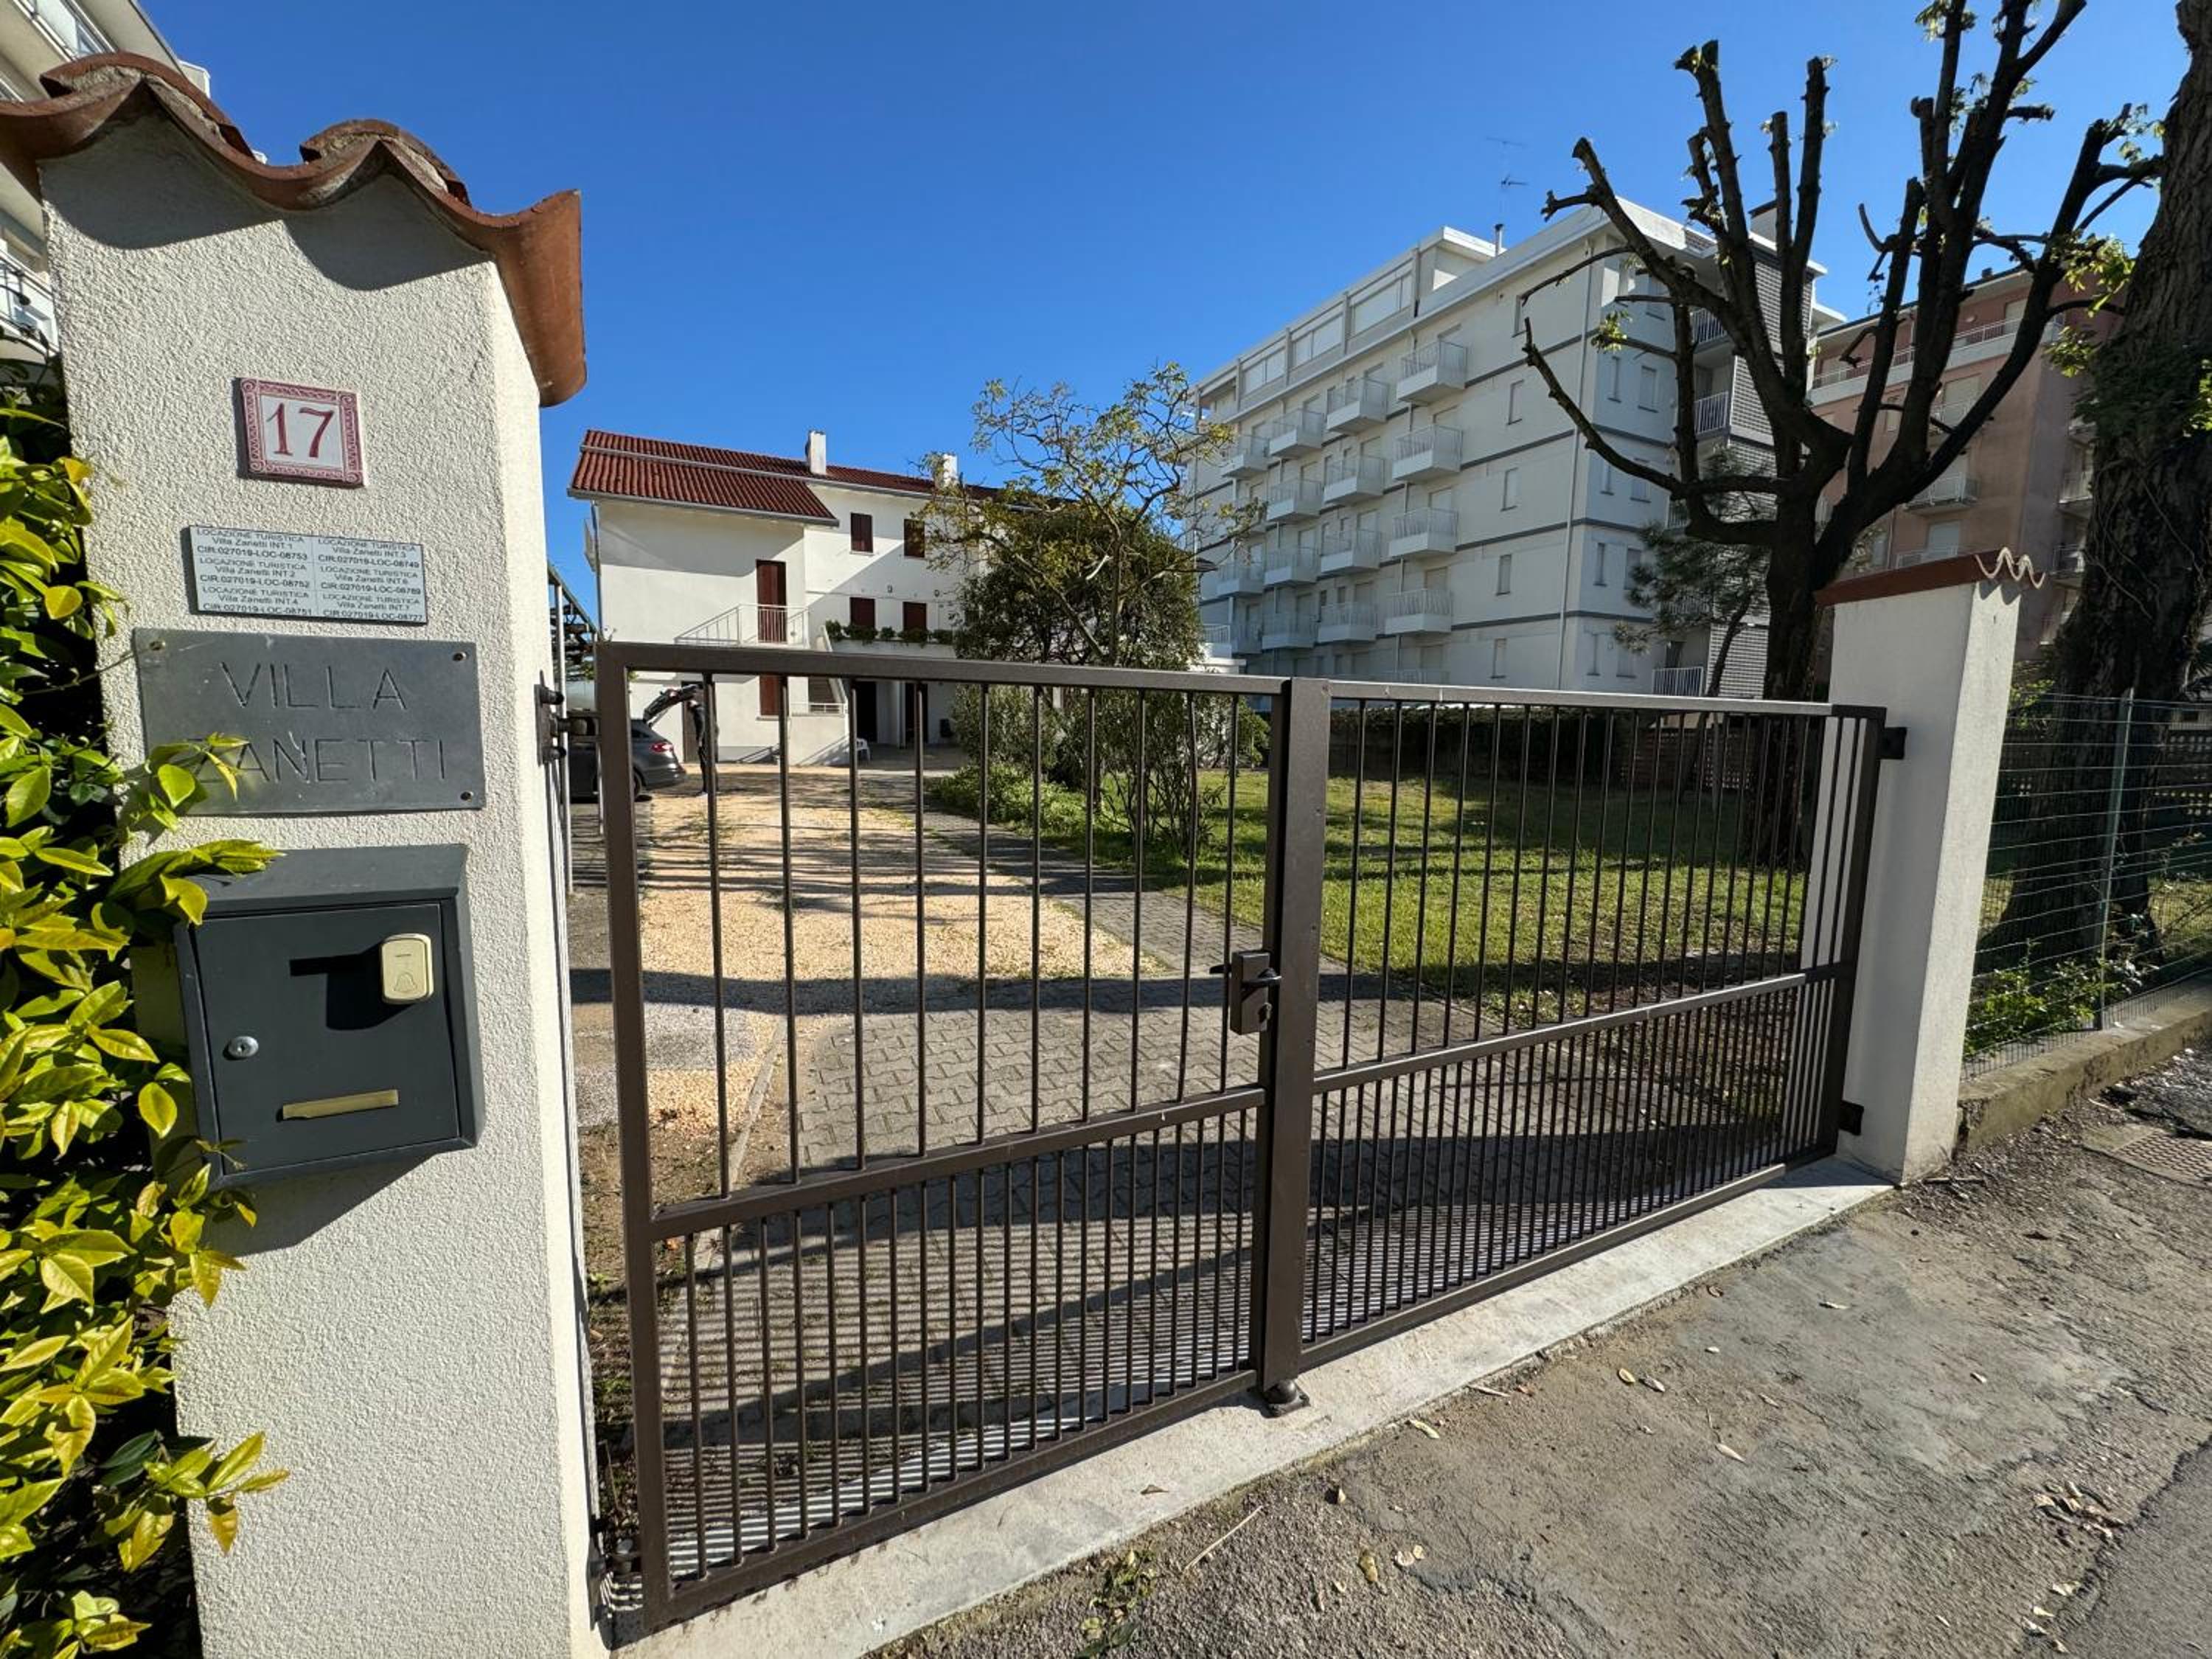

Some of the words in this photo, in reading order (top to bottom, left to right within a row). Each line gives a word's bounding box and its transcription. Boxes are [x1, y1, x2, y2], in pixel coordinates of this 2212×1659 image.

[265, 403, 335, 459] 17
[197, 529, 251, 538] LOCAZIONE
[256, 532, 305, 543] TURISTICA
[212, 537, 232, 545] Villa
[318, 539, 367, 548] LOCAZIONE
[372, 542, 416, 552] TURISTICA
[200, 557, 254, 567] LOCAZIONE
[259, 561, 307, 570] TURISTICA
[215, 566, 235, 574] Villa
[320, 566, 372, 575] LOCAZIONE
[373, 569, 418, 578] TURISTICA
[334, 574, 353, 582] Villa
[202, 586, 257, 595] LOCAZIONE
[260, 590, 309, 598] TURISTICA
[322, 594, 373, 602] LOCAZIONE
[220, 661, 407, 710] VILLA
